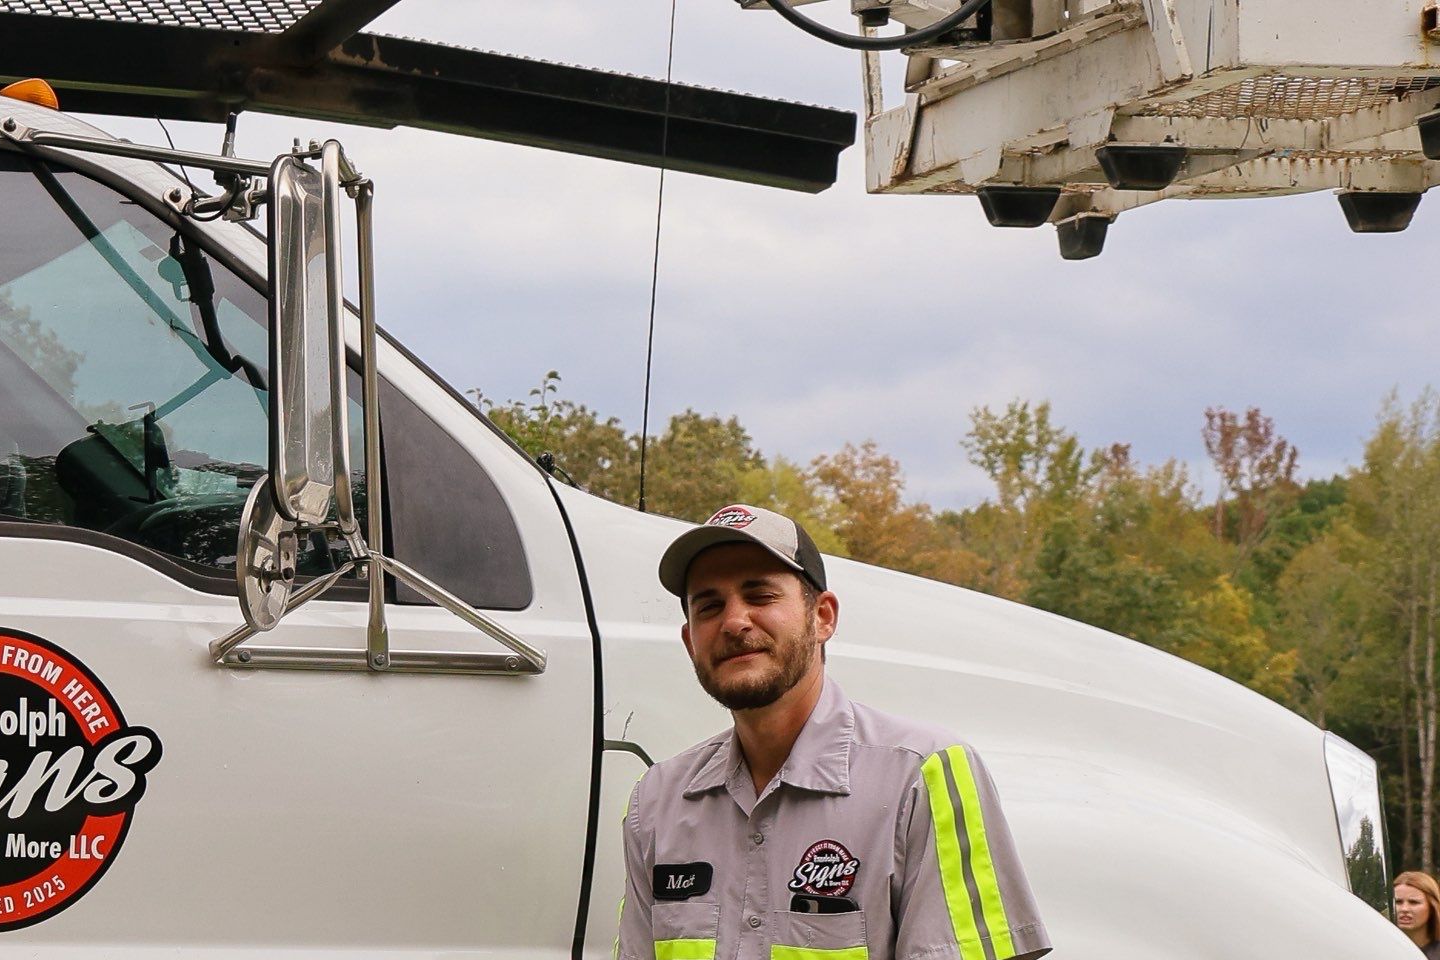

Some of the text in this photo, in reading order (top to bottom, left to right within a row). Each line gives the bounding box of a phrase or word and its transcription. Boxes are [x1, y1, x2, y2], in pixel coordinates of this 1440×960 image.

[2, 645, 63, 685] FROM
[62, 678, 110, 734] HERE
[6, 834, 62, 859] More
[69, 835, 105, 860] LLC
[789, 860, 858, 889] Signs
[23, 874, 66, 908] 2025
